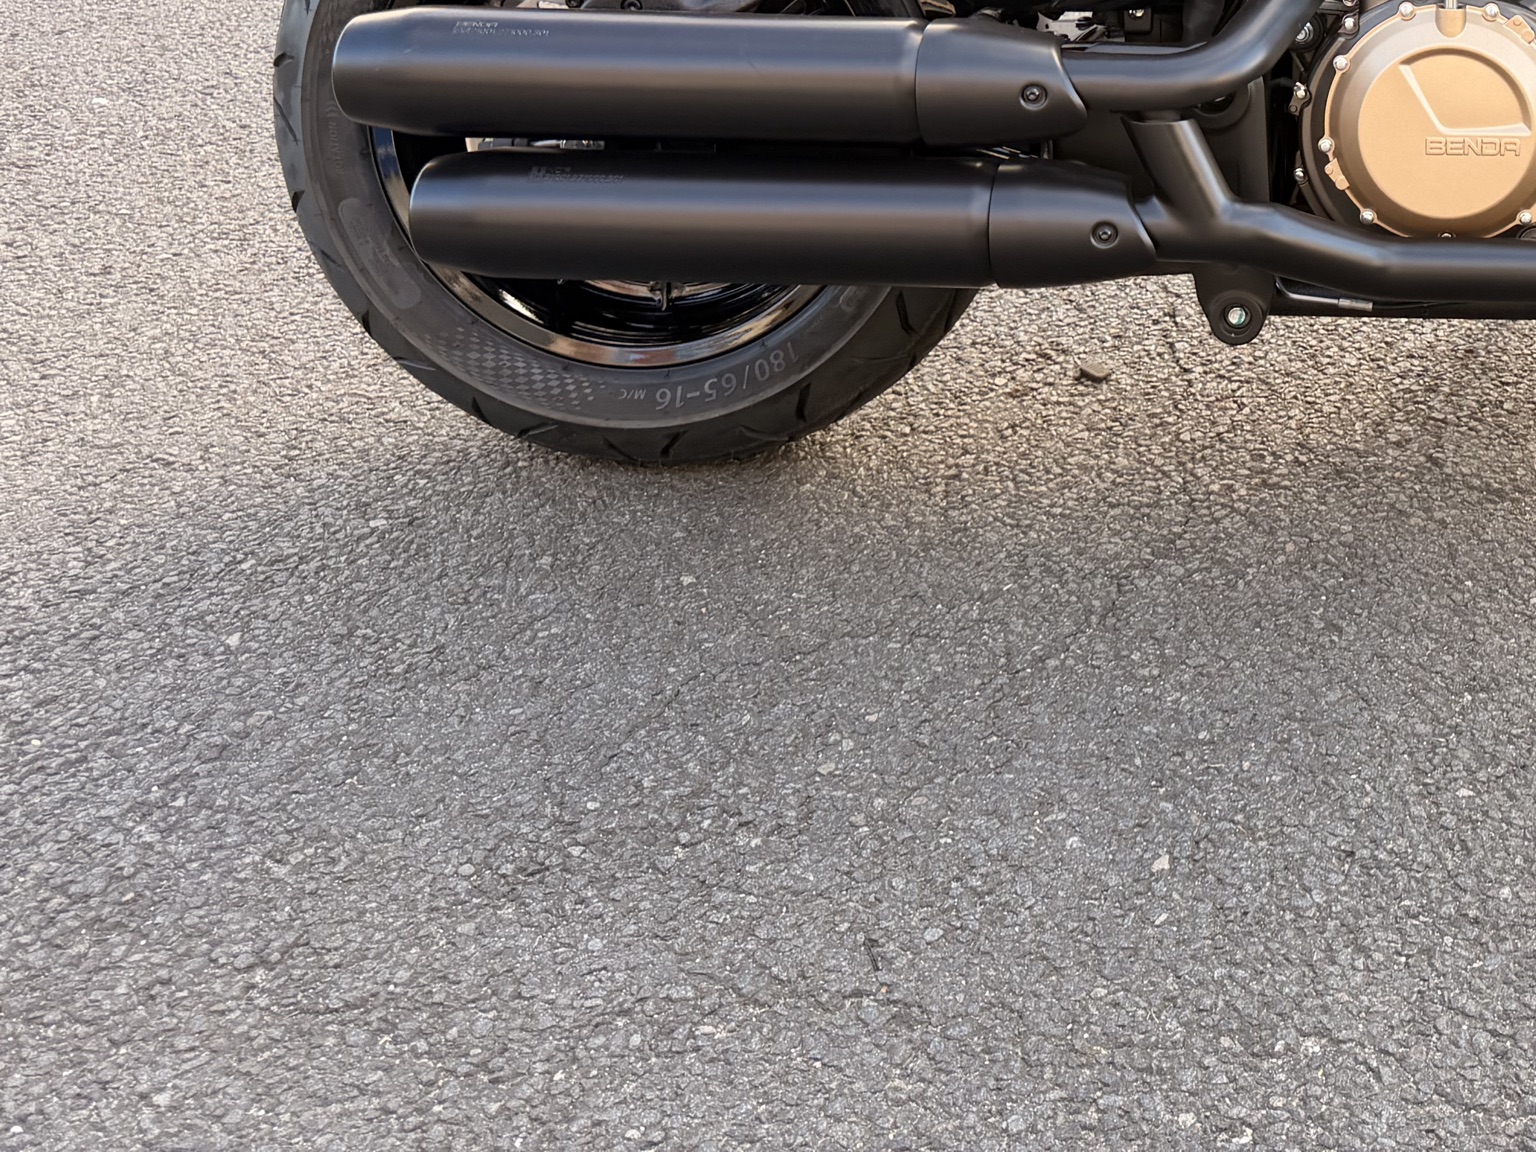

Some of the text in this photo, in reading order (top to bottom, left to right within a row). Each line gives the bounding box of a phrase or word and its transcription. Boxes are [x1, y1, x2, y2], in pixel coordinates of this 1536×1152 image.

[1424, 136, 1521, 157] BENDA
[619, 341, 800, 411] 180/65-16 M/C
